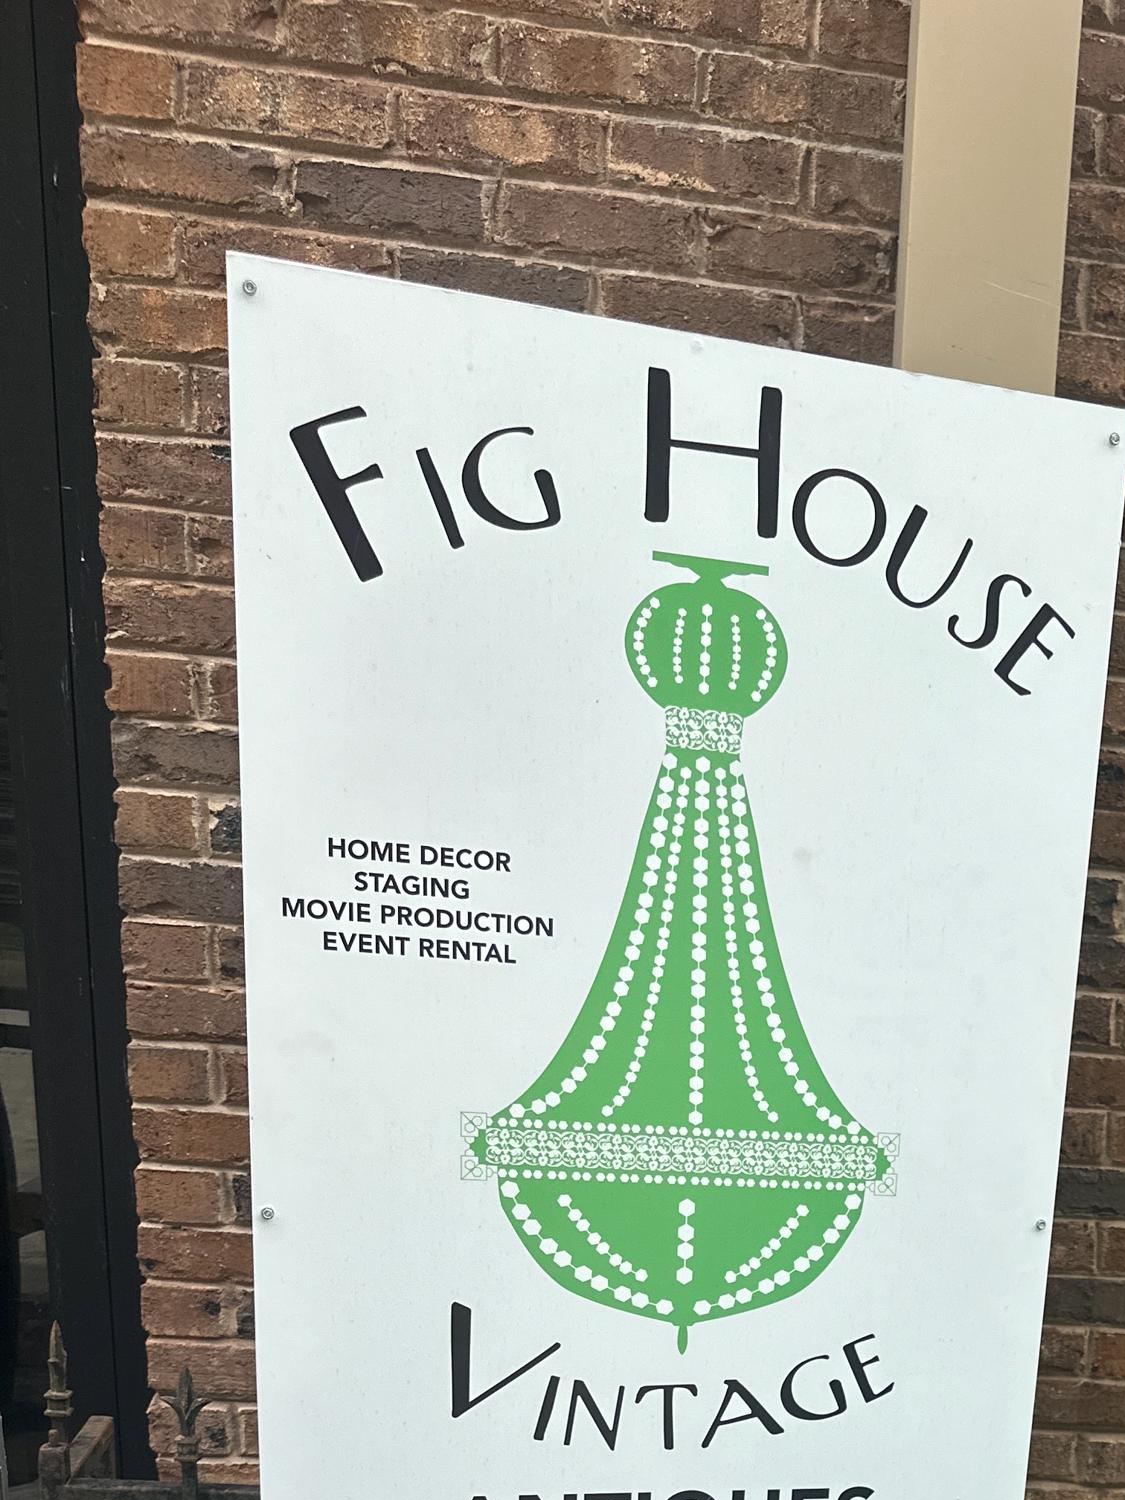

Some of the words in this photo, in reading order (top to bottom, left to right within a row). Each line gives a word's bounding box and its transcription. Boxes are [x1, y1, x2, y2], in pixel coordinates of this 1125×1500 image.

[327, 837, 411, 864] HOME
[420, 845, 511, 872] DECOR
[354, 871, 470, 899] STAGING
[282, 897, 371, 923] MOVIE
[381, 905, 554, 937] PRODUCTION
[322, 931, 411, 956] EVENT
[419, 938, 517, 964] RENTAL
[451, 1302, 895, 1451] VINTAGE
